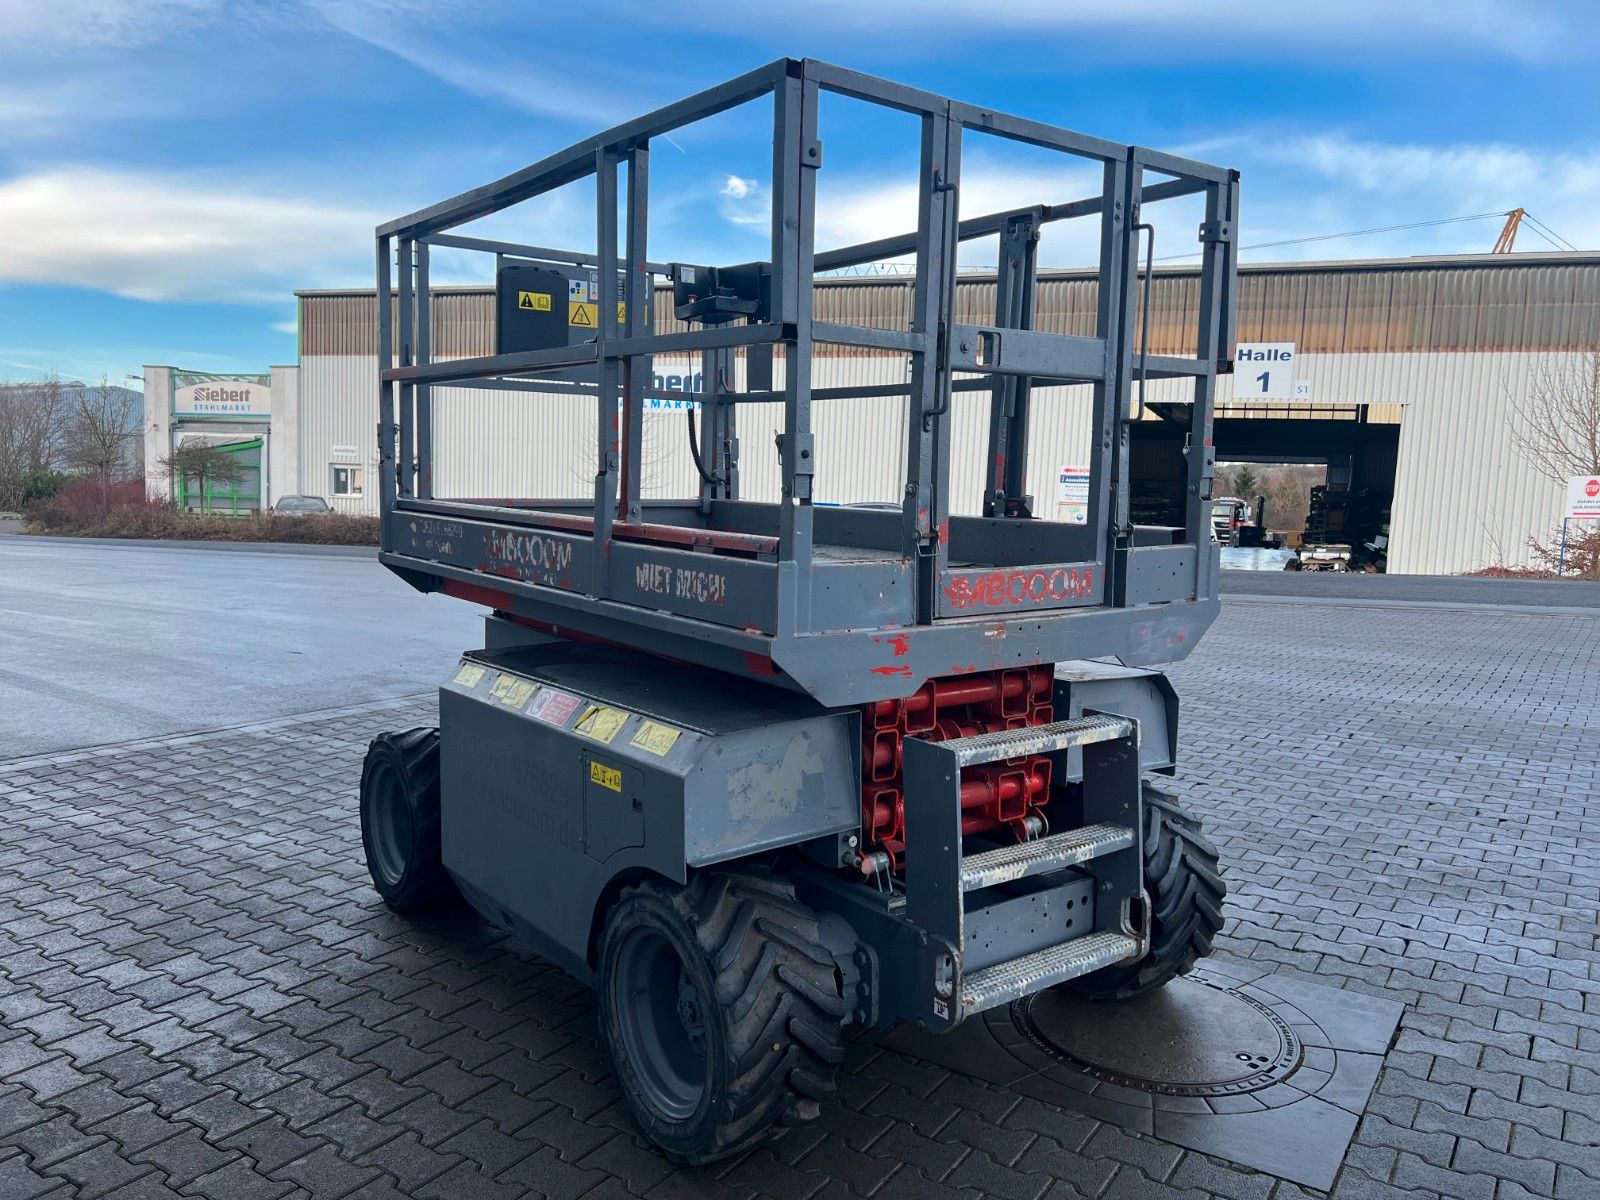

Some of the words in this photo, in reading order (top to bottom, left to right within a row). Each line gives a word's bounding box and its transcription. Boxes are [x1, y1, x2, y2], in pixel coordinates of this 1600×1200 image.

[1238, 349, 1292, 361] Halle
[1256, 371, 1270, 393] 1
[194, 387, 251, 401] Siebert
